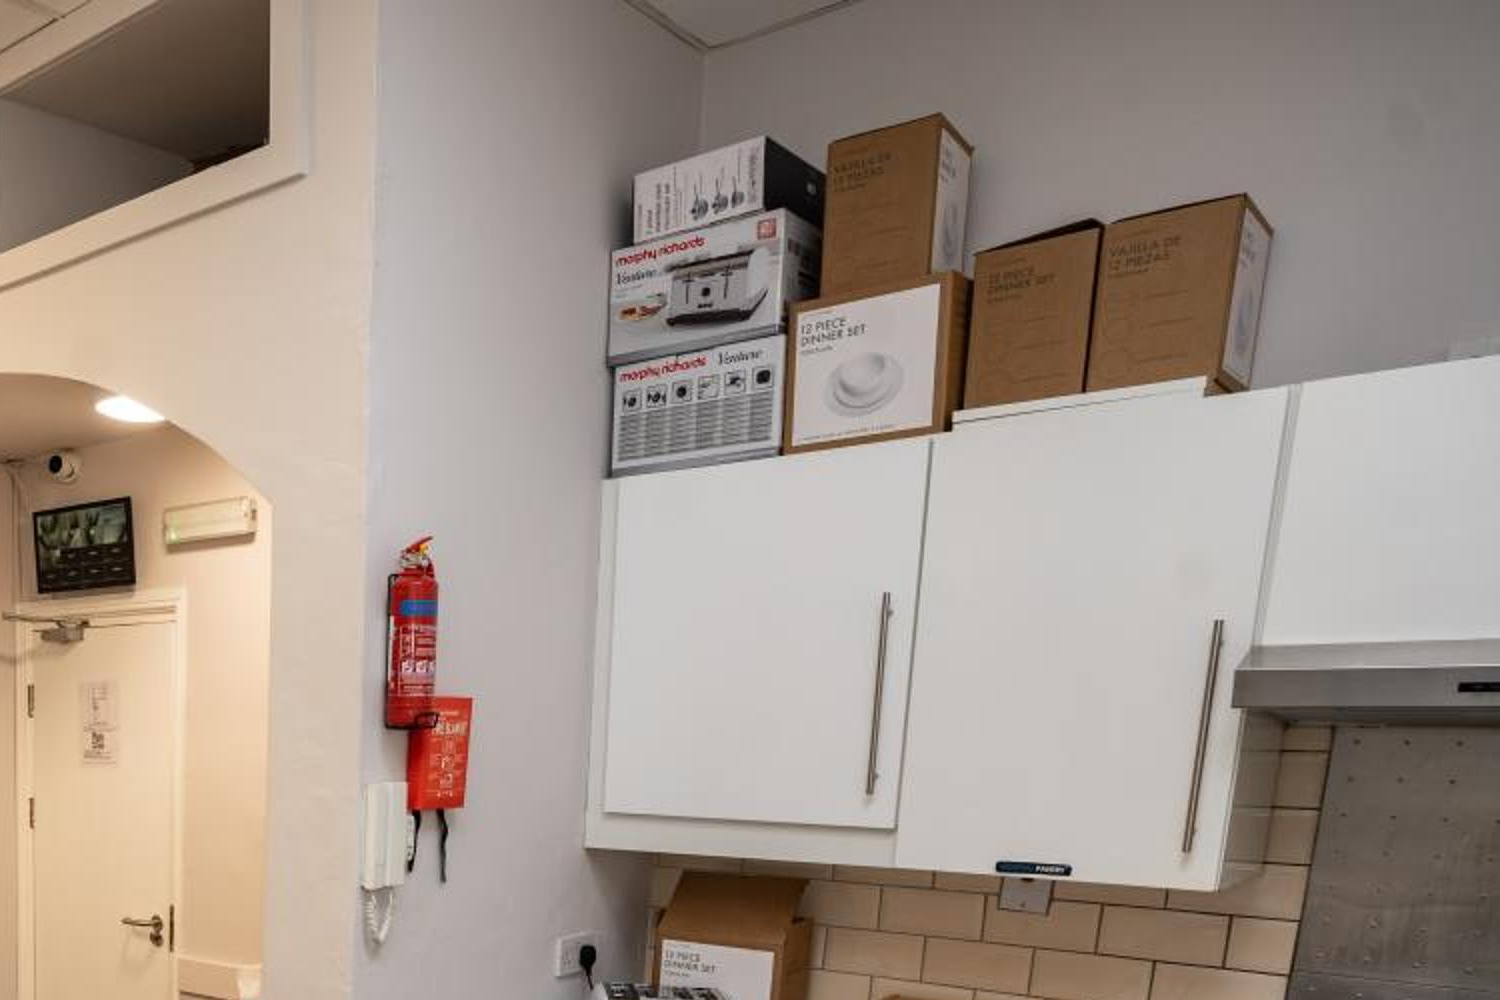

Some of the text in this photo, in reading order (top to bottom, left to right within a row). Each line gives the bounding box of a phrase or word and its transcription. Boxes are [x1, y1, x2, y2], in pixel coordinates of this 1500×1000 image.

[616, 236, 706, 268] morphy richards
[1109, 240, 1160, 257] VAJILLA
[801, 323, 866, 347] DINNER SET
[815, 317, 847, 332] PIECE
[619, 368, 660, 384] morphy
[662, 357, 709, 376] richards
